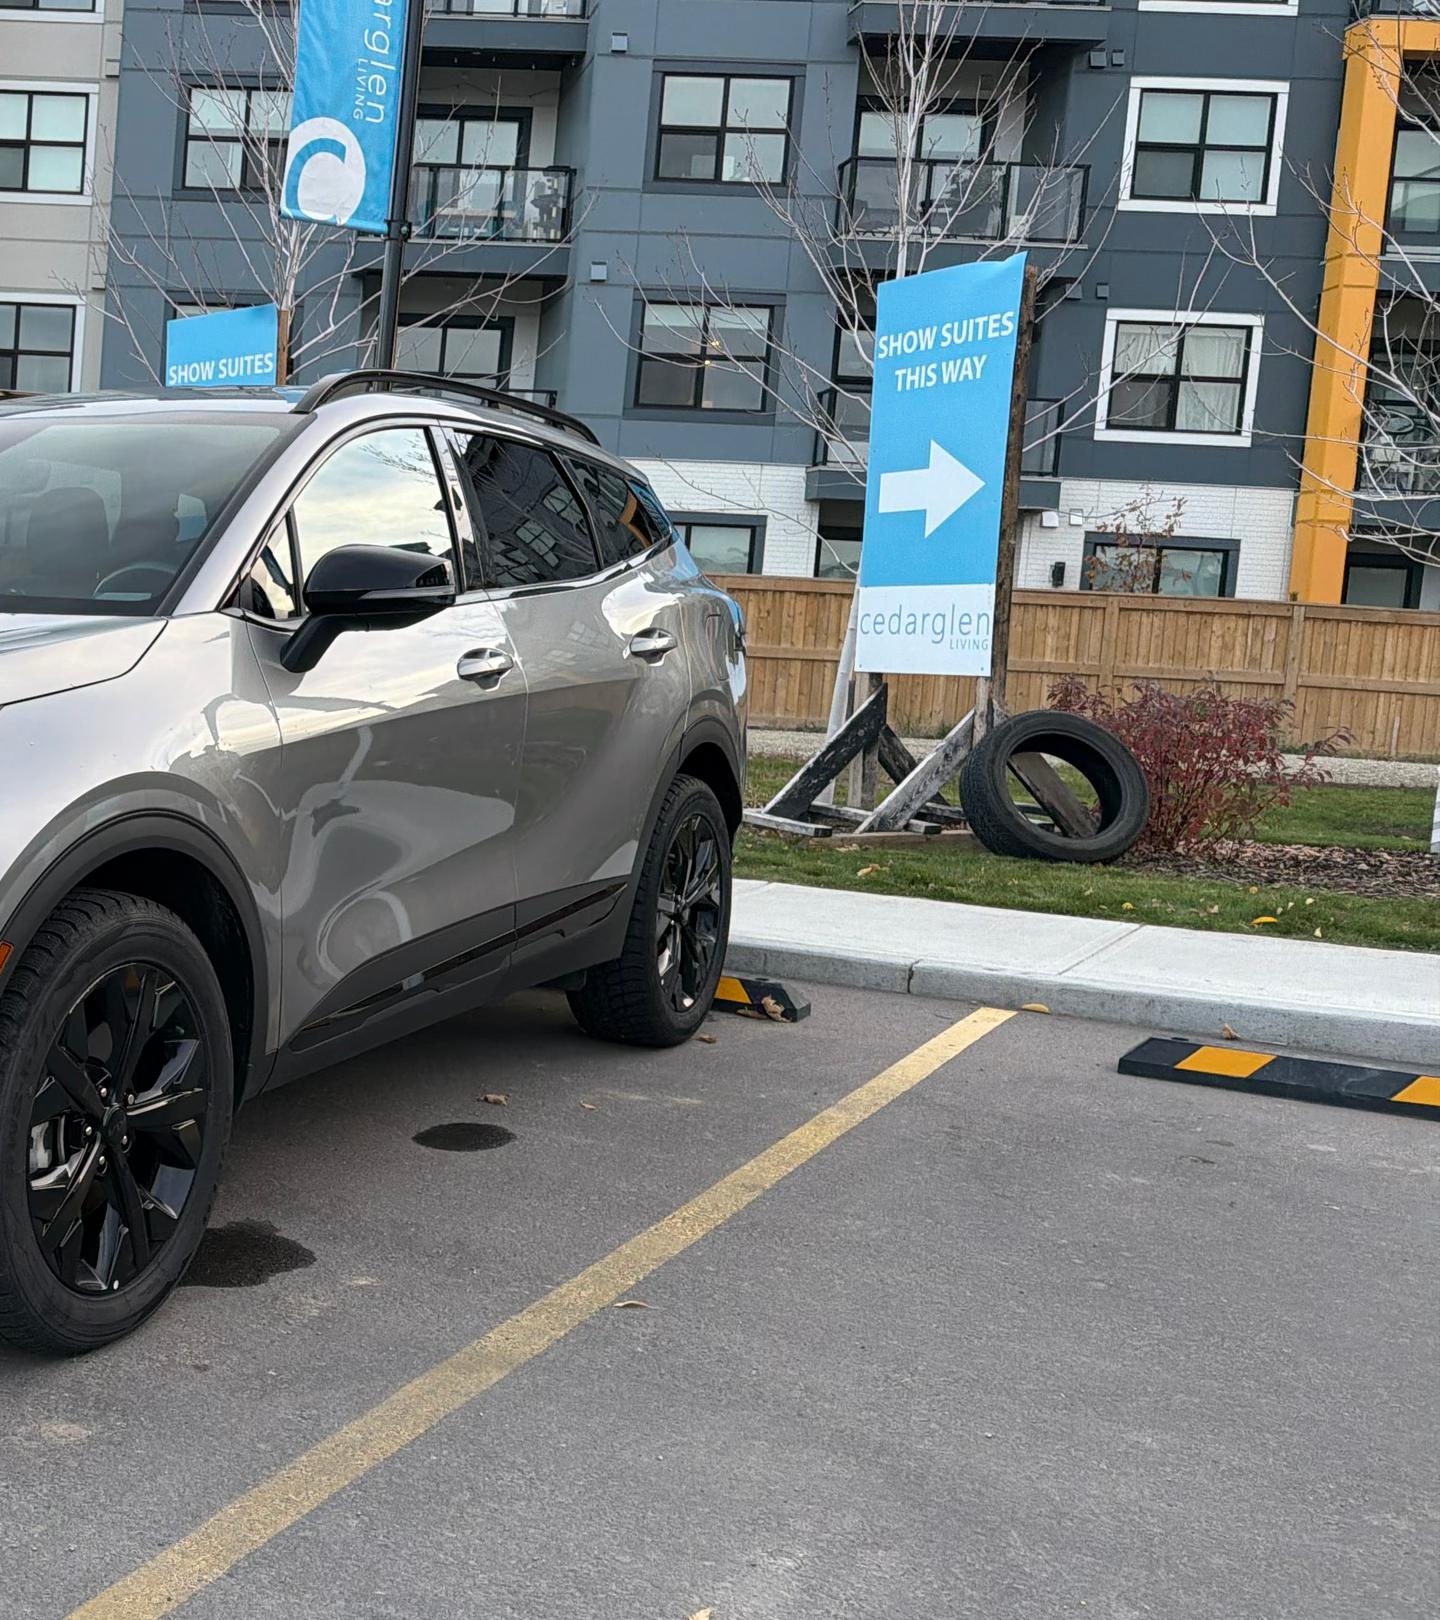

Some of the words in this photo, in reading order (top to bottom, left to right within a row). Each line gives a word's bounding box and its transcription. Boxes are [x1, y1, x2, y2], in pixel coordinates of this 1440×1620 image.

[352, 58, 368, 120] LIVING
[877, 325, 938, 360] SHOW
[940, 311, 1015, 348] SUITES
[168, 360, 215, 386] SHOW
[218, 352, 274, 379] SUITES
[894, 363, 938, 393] THIS
[941, 354, 988, 385] WAY
[860, 603, 990, 645] cedarglen
[949, 639, 989, 651] LIVING
